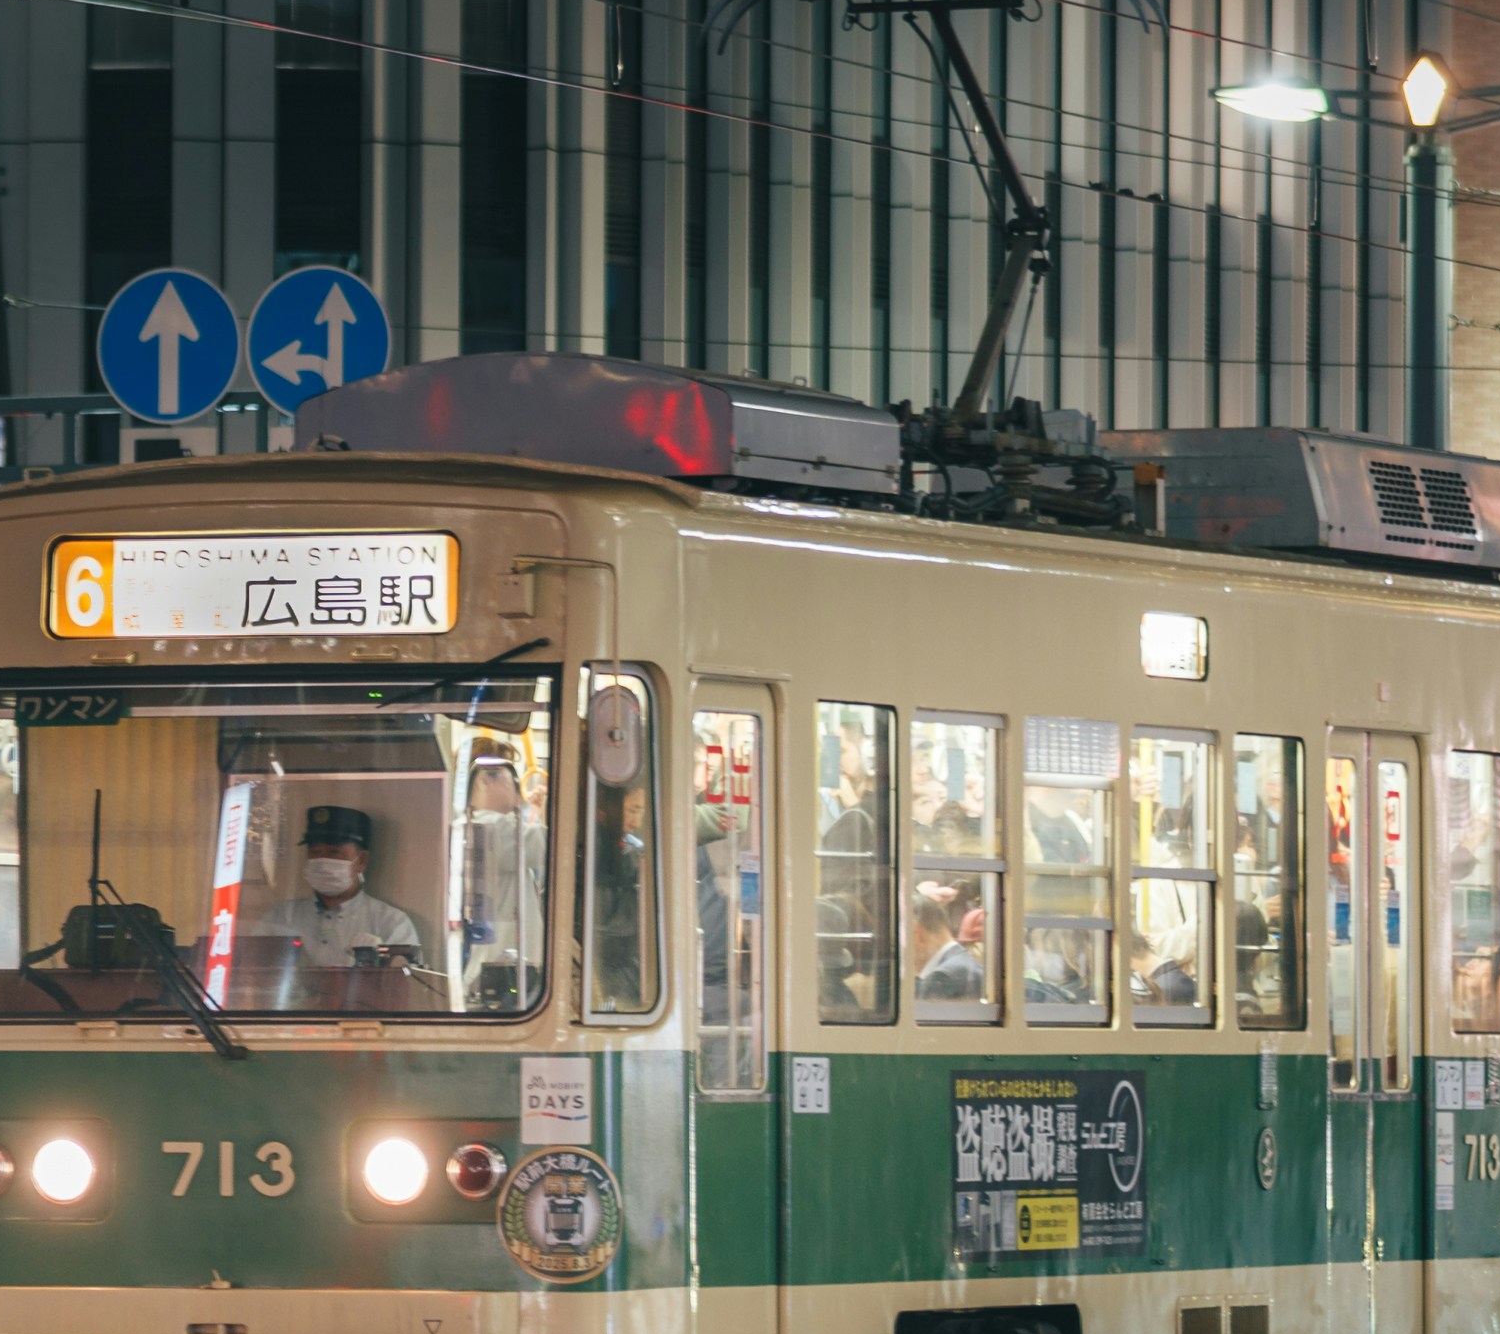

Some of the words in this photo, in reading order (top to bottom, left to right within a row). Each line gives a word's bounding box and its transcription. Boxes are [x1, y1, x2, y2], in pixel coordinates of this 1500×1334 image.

[119, 548, 291, 569] HIROSHIMA
[307, 545, 438, 566] STATION
[65, 555, 105, 628] 6
[240, 574, 438, 629] 広島駅
[20, 695, 118, 720] ワンマン
[528, 1095, 585, 1109] DAYS
[550, 1082, 585, 1090] MOBIRY
[955, 1104, 1056, 1183] 盗聴盗撮
[1464, 1133, 1500, 1182] 713
[161, 1141, 296, 1197] 713
[513, 1153, 611, 1193] 駅前大橋ルート
